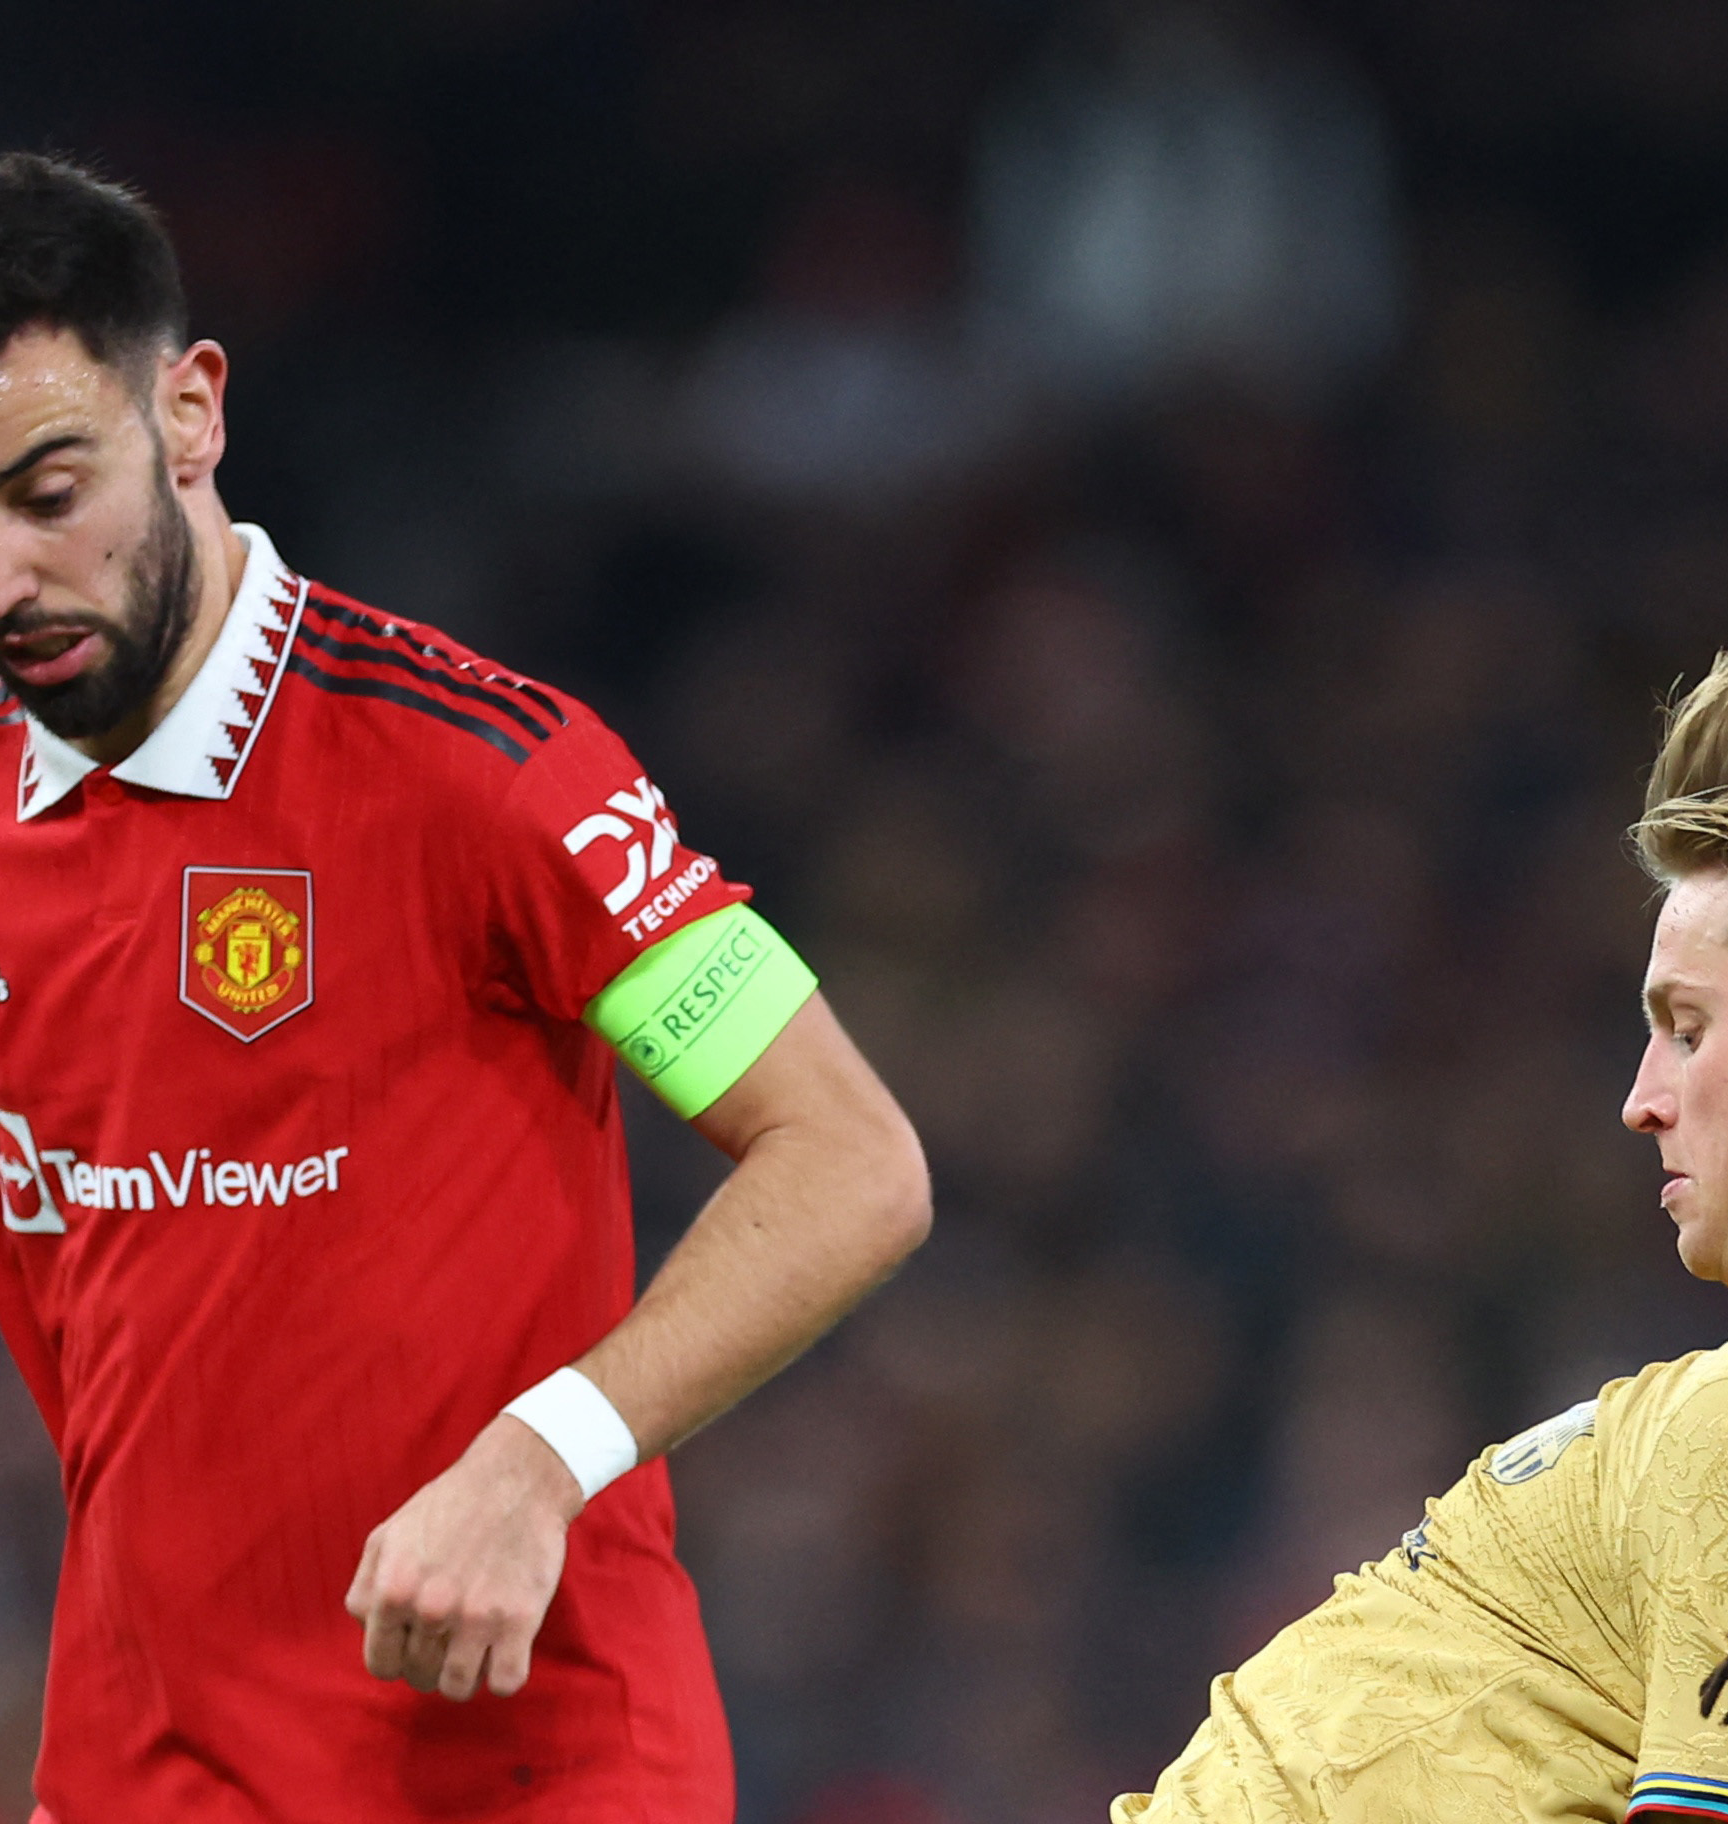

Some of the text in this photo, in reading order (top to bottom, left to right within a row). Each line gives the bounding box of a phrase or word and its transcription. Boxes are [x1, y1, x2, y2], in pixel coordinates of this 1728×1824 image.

[562, 776, 680, 916] DX
[621, 856, 720, 942] TECHNO
[661, 926, 762, 1041] RESPECT
[39, 1145, 350, 1211] TeamViewer
